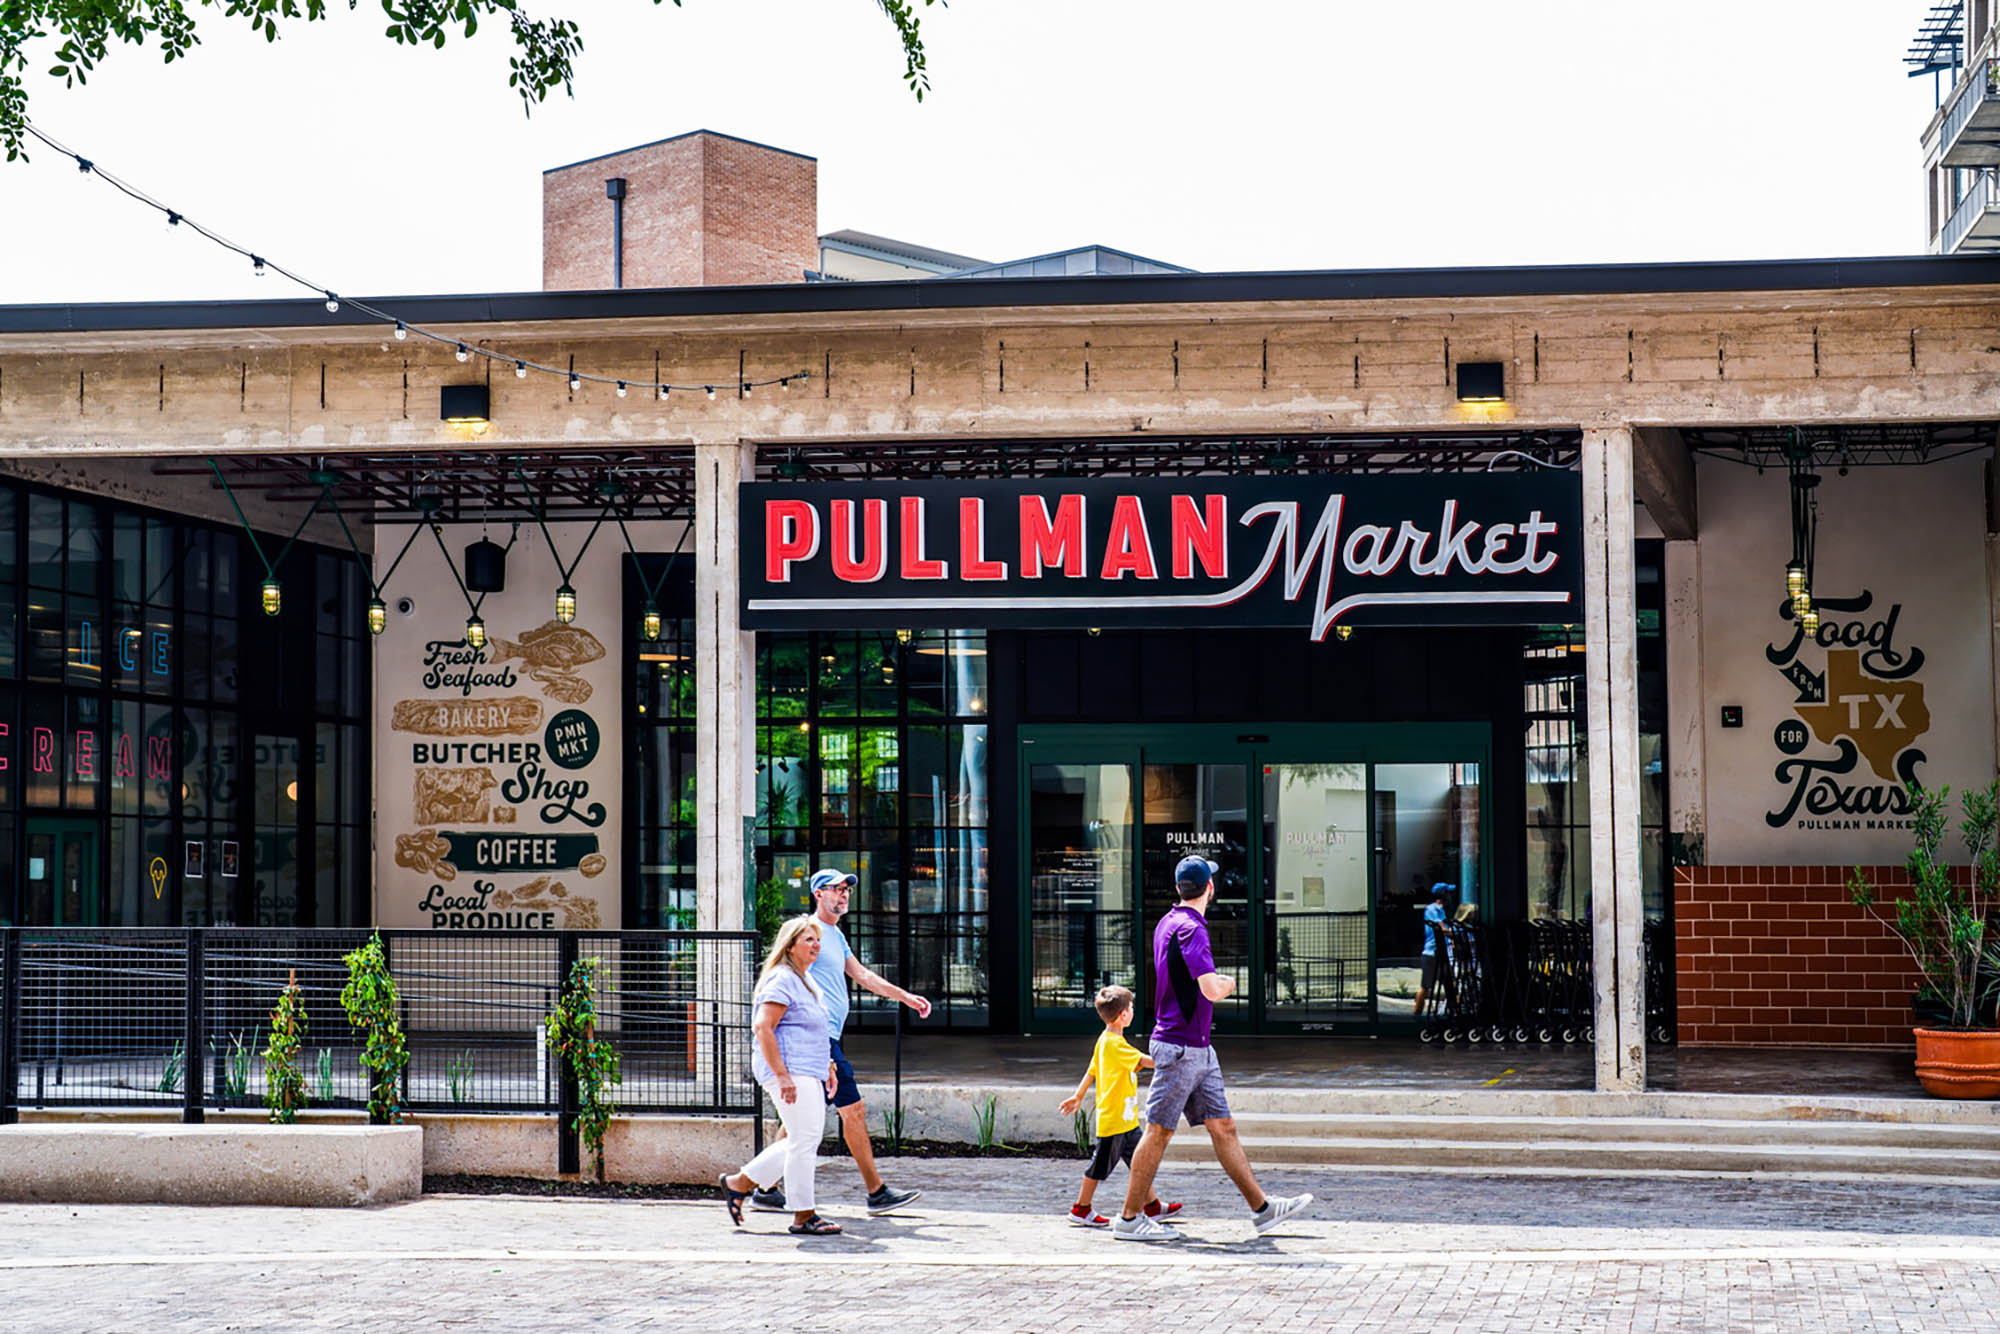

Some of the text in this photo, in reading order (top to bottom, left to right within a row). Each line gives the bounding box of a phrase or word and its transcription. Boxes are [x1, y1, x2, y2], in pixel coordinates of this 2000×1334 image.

[765, 494, 1560, 641] PULLMAN Market
[81, 621, 169, 675] ICE
[1766, 589, 1925, 679] Food
[424, 638, 488, 666] Fresh
[423, 662, 517, 696] Seafood
[1792, 667, 1822, 699] FROM
[438, 707, 512, 728] BAKERY
[1839, 694, 1907, 729] TX
[554, 721, 587, 742] PMN
[1780, 730, 1803, 743] FOR
[413, 743, 541, 764] BUTCHER
[557, 737, 588, 758] MKT
[501, 761, 606, 827] Shop
[1766, 748, 1927, 828] Texas
[1166, 832, 1224, 844] PULLMAN
[1798, 820, 1913, 830] PULLMAN MARKE
[476, 839, 557, 864] COFFEE
[418, 880, 495, 911] Local
[432, 912, 555, 929] PRODUCE
